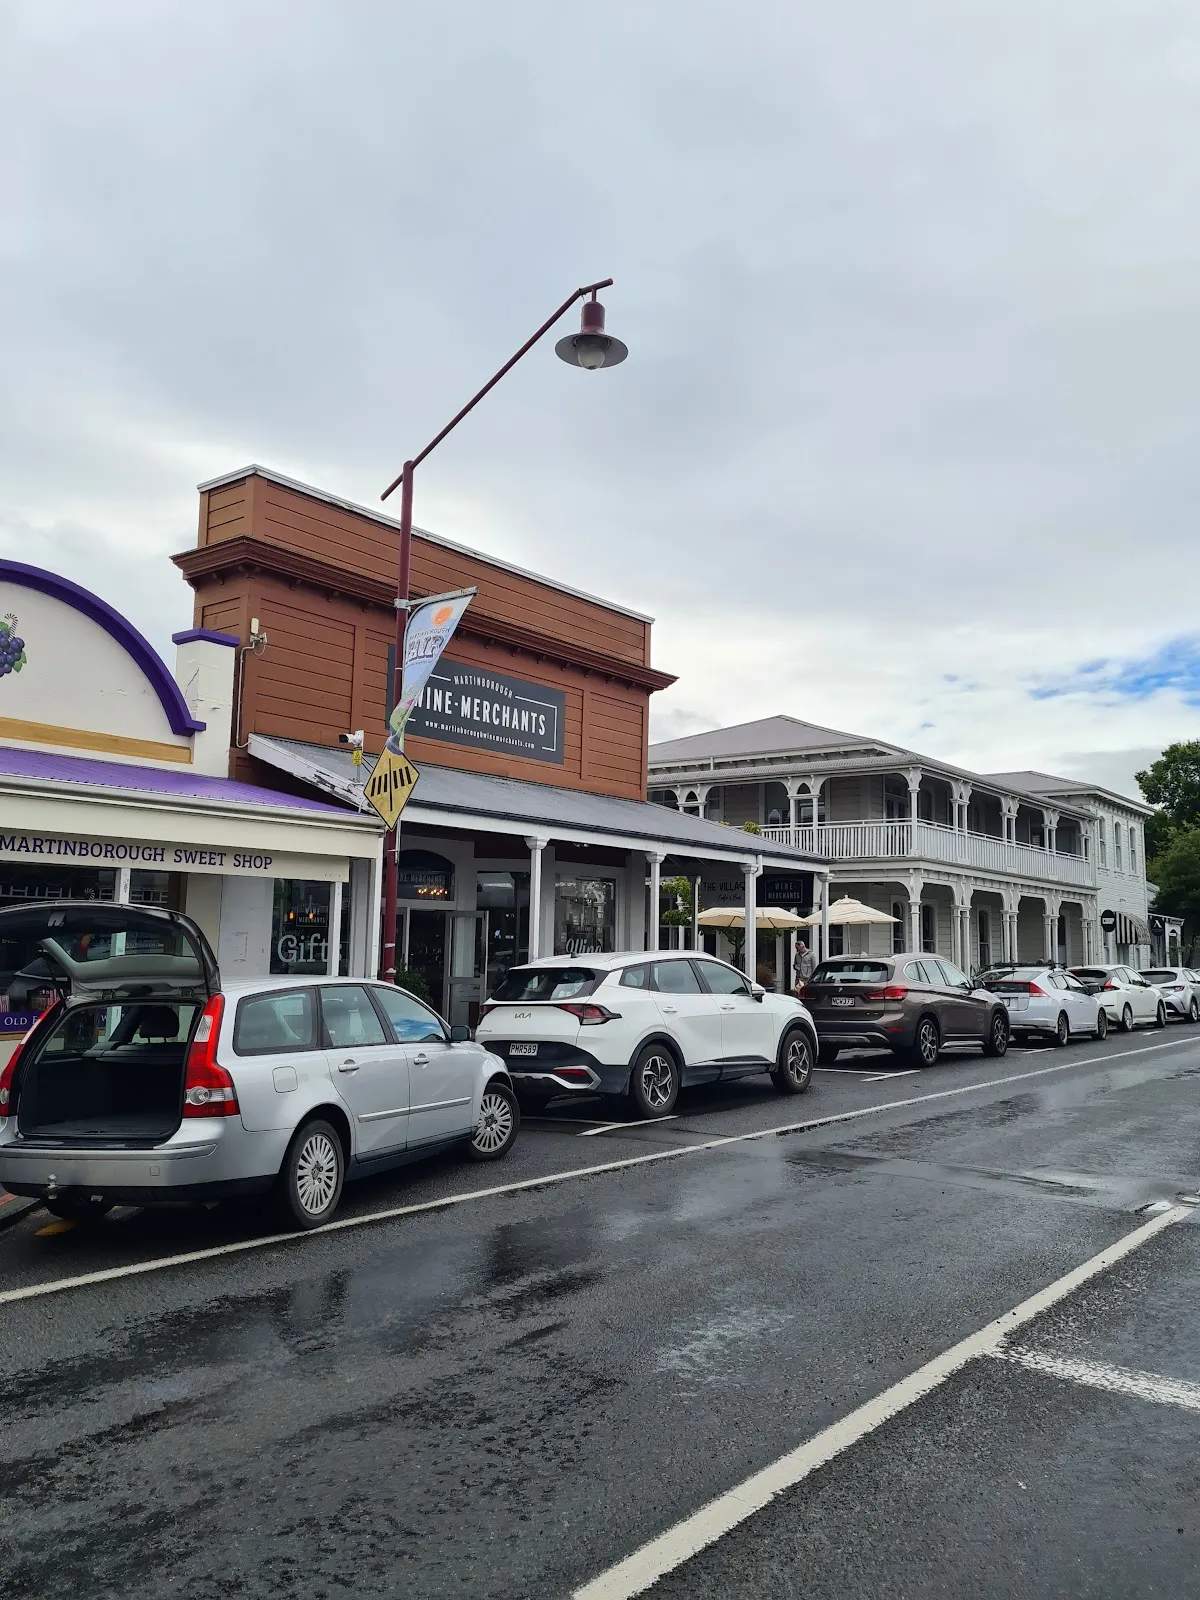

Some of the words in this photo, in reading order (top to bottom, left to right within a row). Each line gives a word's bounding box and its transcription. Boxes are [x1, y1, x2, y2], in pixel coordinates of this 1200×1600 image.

[453, 675, 513, 699] MARTINBOROUGH
[425, 720, 535, 749] www.martinboroughwinemerchants.com
[0, 834, 165, 862] MARTINBOROUGH
[173, 849, 227, 867] SWEET
[233, 853, 273, 870] SHOP
[703, 881, 716, 892] THE
